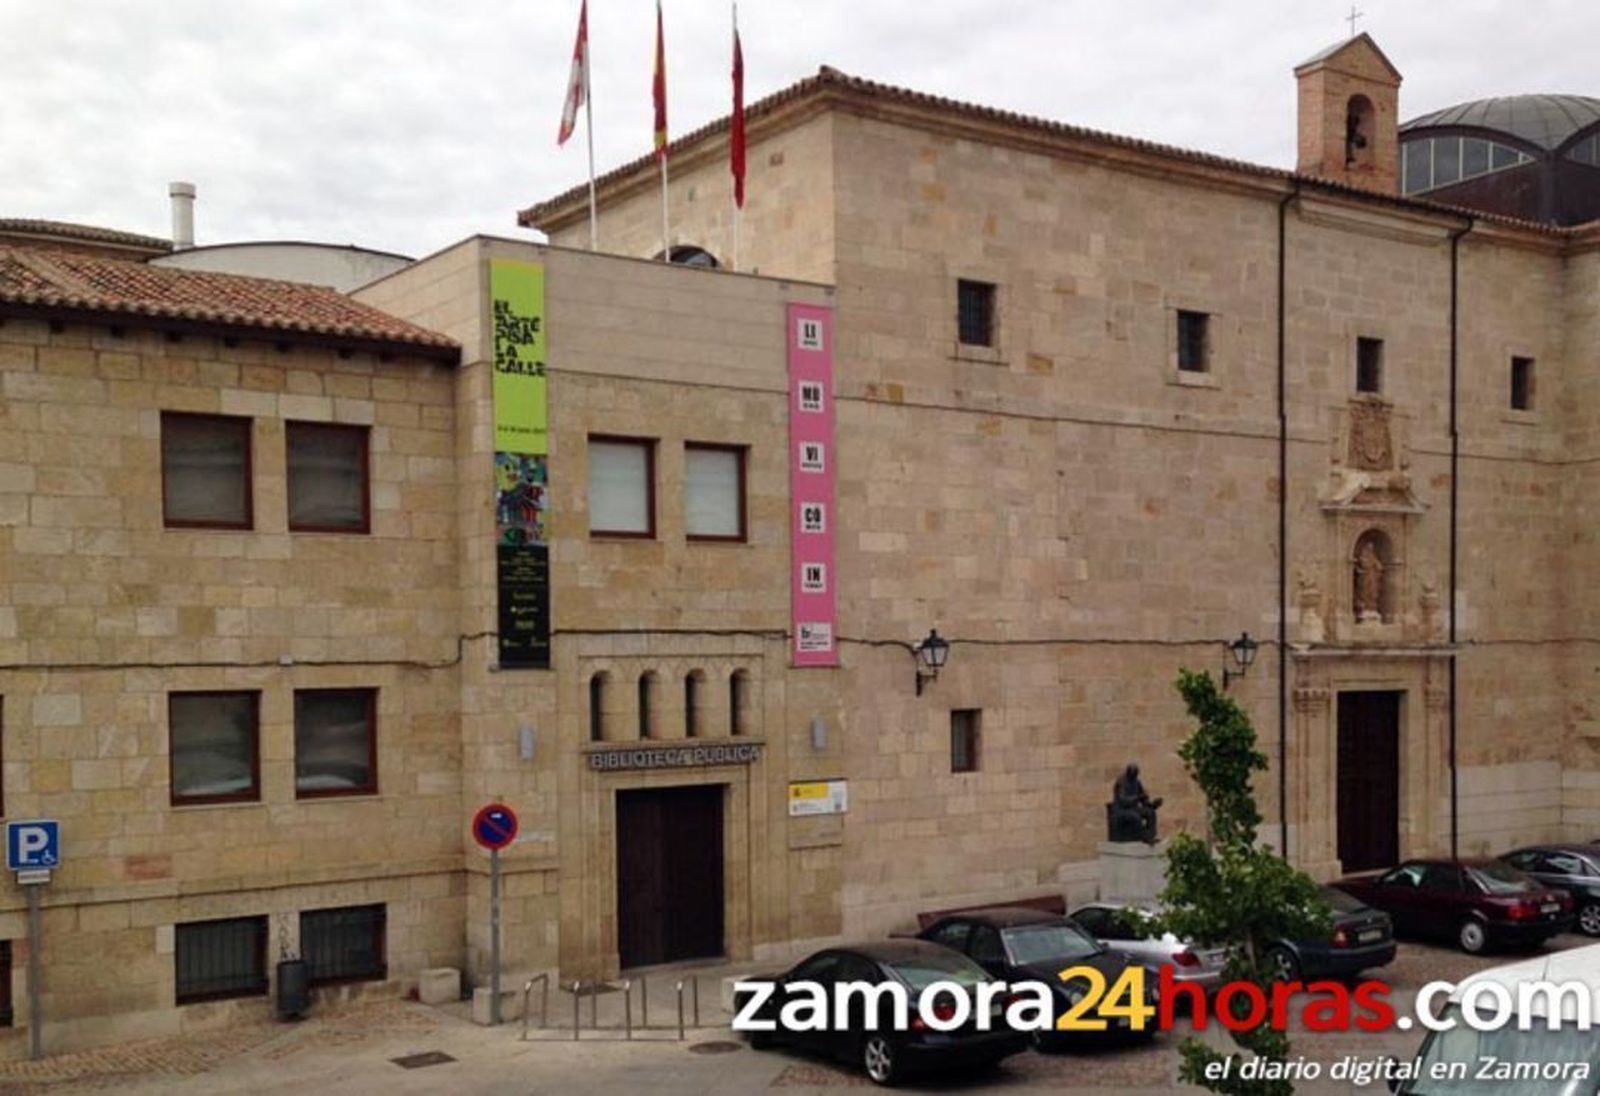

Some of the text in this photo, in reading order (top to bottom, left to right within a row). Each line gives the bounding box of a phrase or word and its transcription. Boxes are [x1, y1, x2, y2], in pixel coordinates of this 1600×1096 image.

[496, 357, 546, 377] CALLE
[802, 385, 820, 401] M
[806, 567, 820, 581] IN
[592, 748, 692, 768] BIBLIOTECA
[18, 827, 48, 863] P
